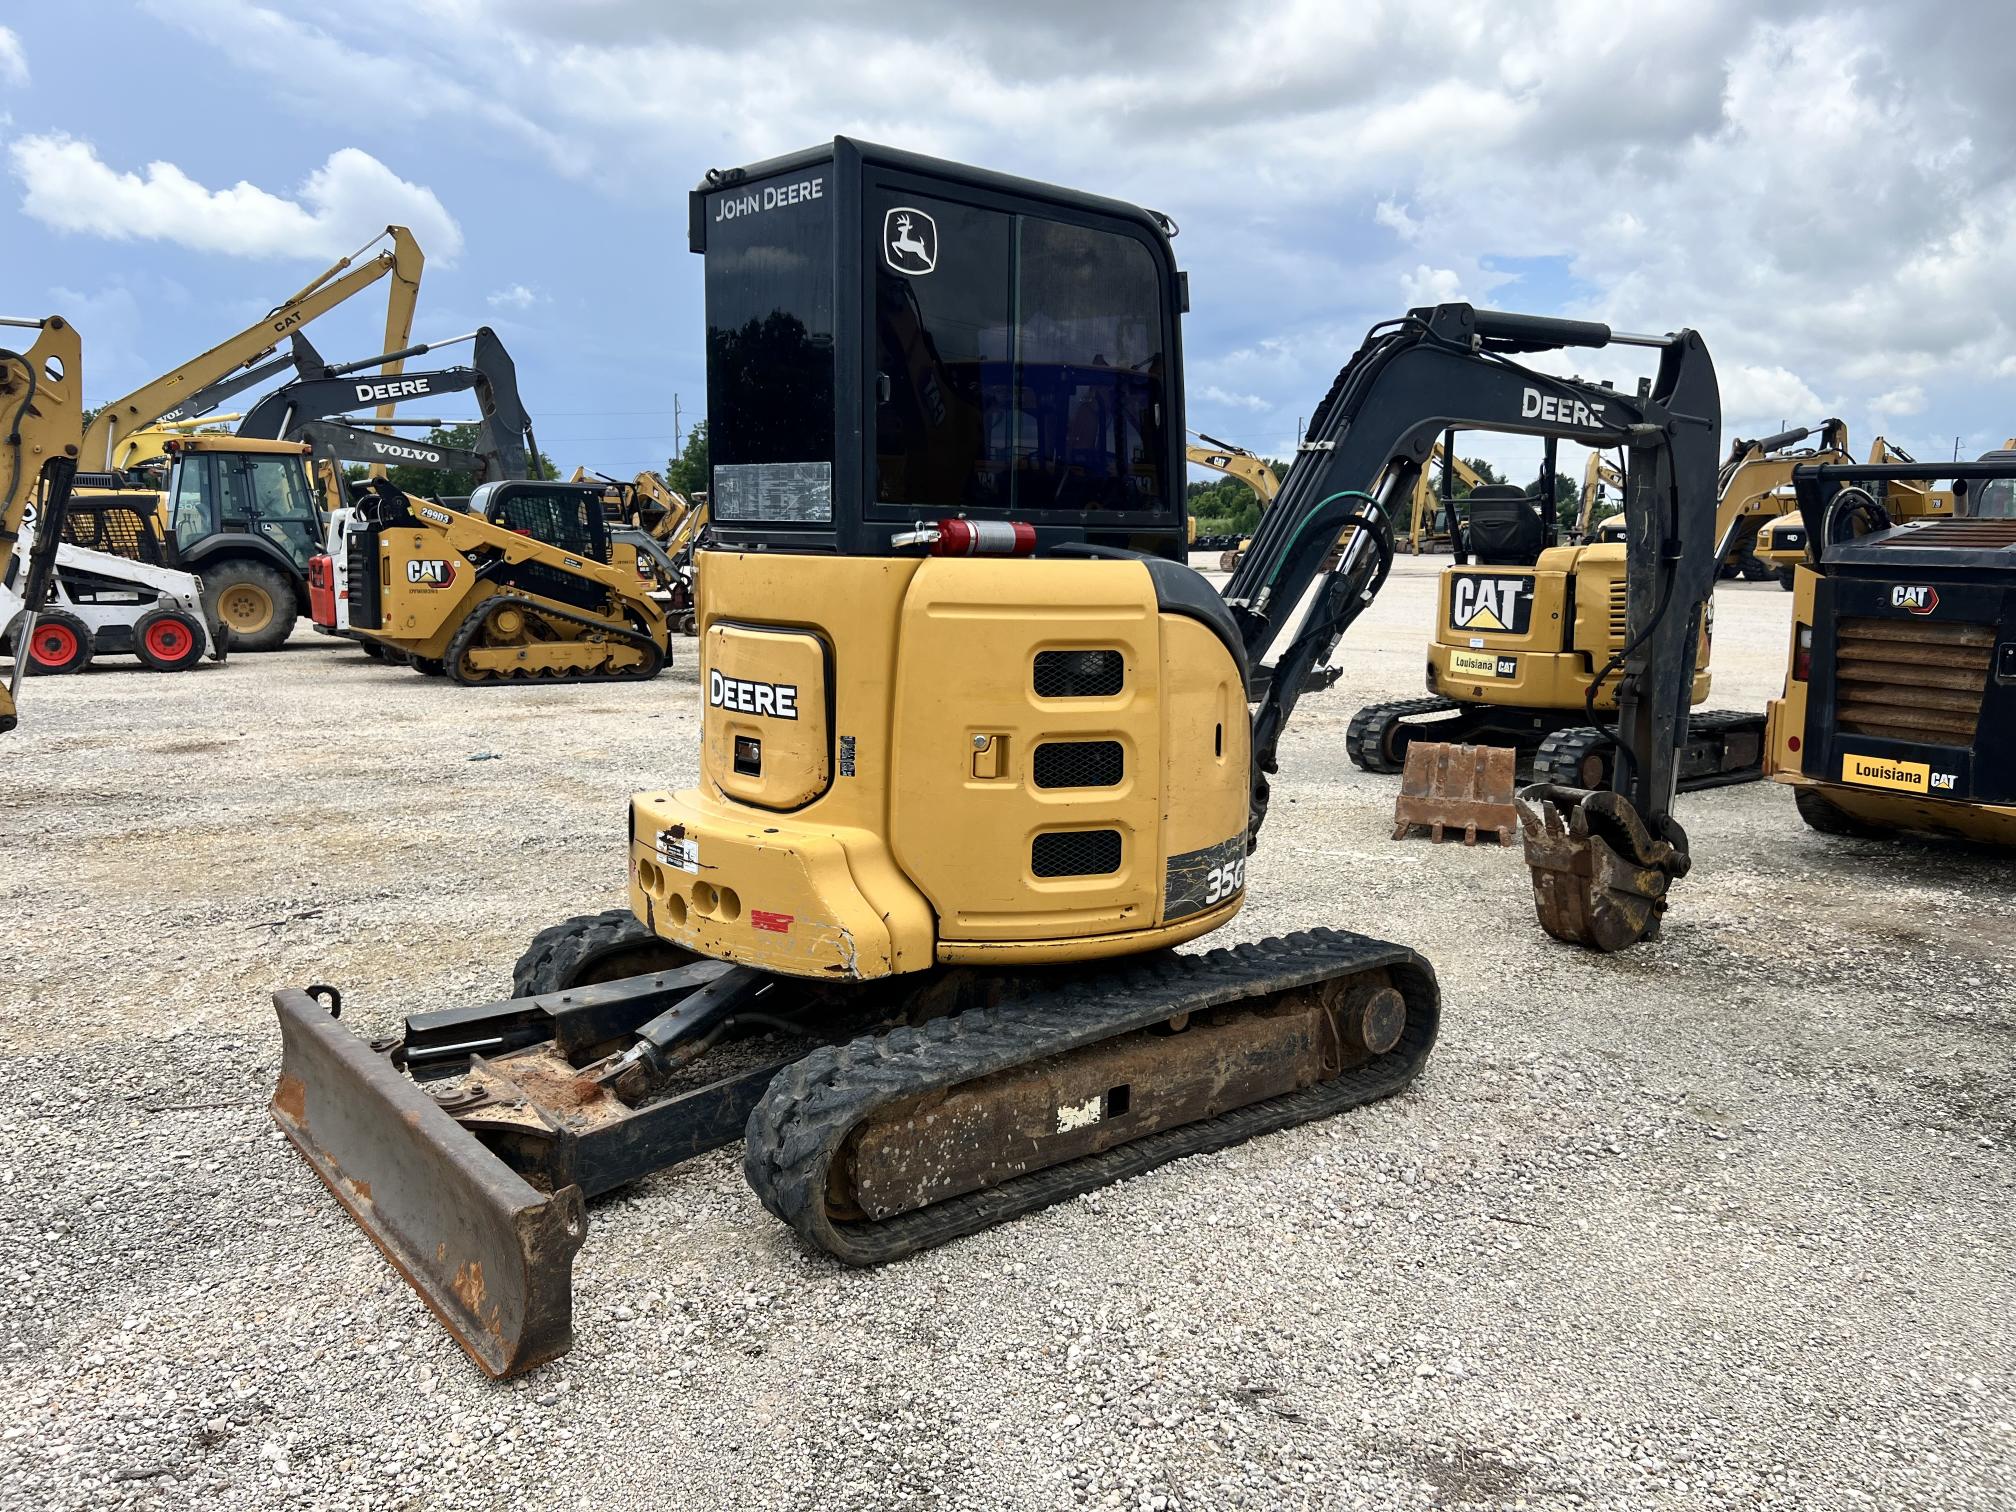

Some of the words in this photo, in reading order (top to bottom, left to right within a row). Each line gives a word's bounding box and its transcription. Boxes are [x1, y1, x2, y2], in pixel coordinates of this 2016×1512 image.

[716, 194, 759, 222] JOHN
[764, 178, 823, 210] DEERE
[274, 311, 301, 332] CAT
[356, 379, 430, 402] DEERE
[1522, 387, 1605, 428] DEERE
[373, 442, 440, 462] VOLVO
[421, 507, 449, 524] 299D3
[407, 560, 444, 583] CAT
[1454, 577, 1524, 630] CAT
[1892, 586, 1928, 607] CAT
[1456, 656, 1493, 671] Louisiana
[1498, 661, 1516, 673] CAT
[710, 670, 797, 718] DEERE
[1856, 762, 1921, 784] Louisiana
[1931, 772, 1958, 789] CAT
